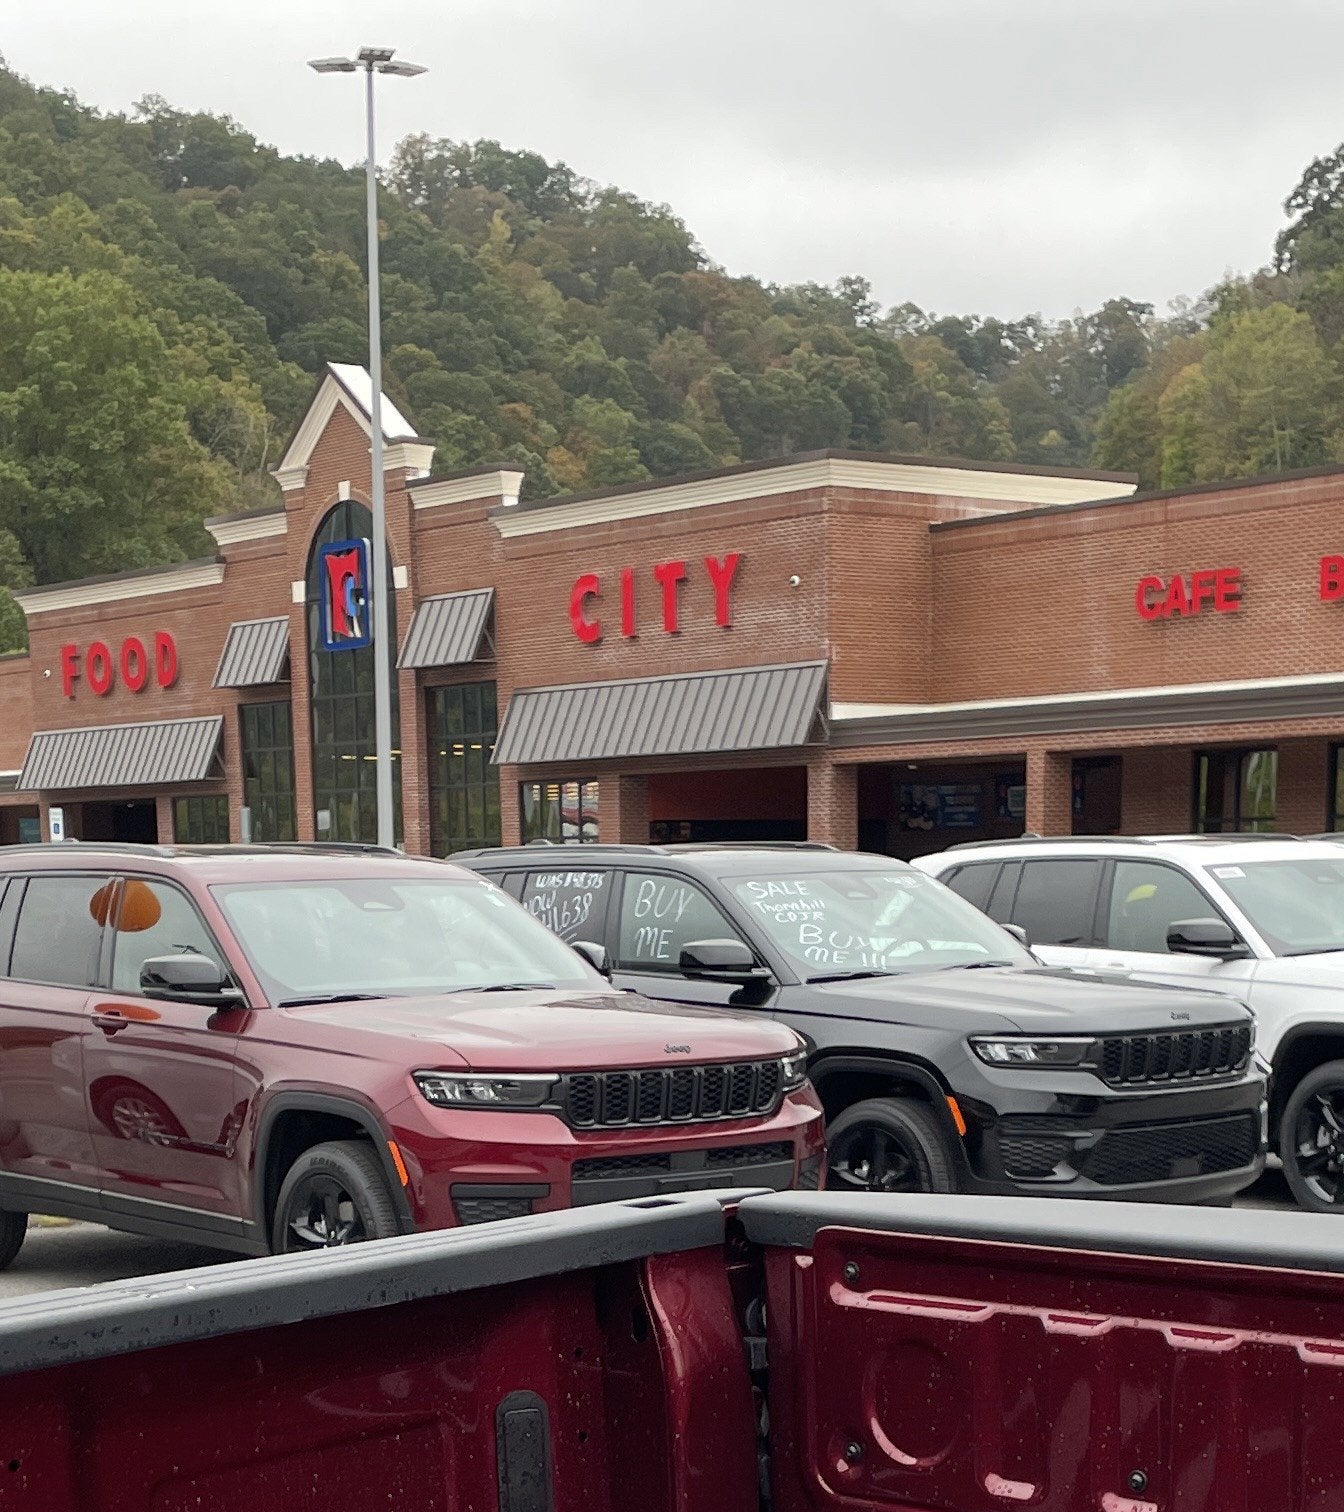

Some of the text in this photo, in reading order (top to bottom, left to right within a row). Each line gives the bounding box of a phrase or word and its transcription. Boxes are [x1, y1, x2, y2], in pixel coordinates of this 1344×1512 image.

[1134, 567, 1241, 621] CAFE
[61, 552, 742, 697] FOOD CITY
[634, 880, 695, 923] BUY
[746, 880, 810, 899] SALE
[634, 926, 674, 959] ME
[804, 946, 850, 964] ME
